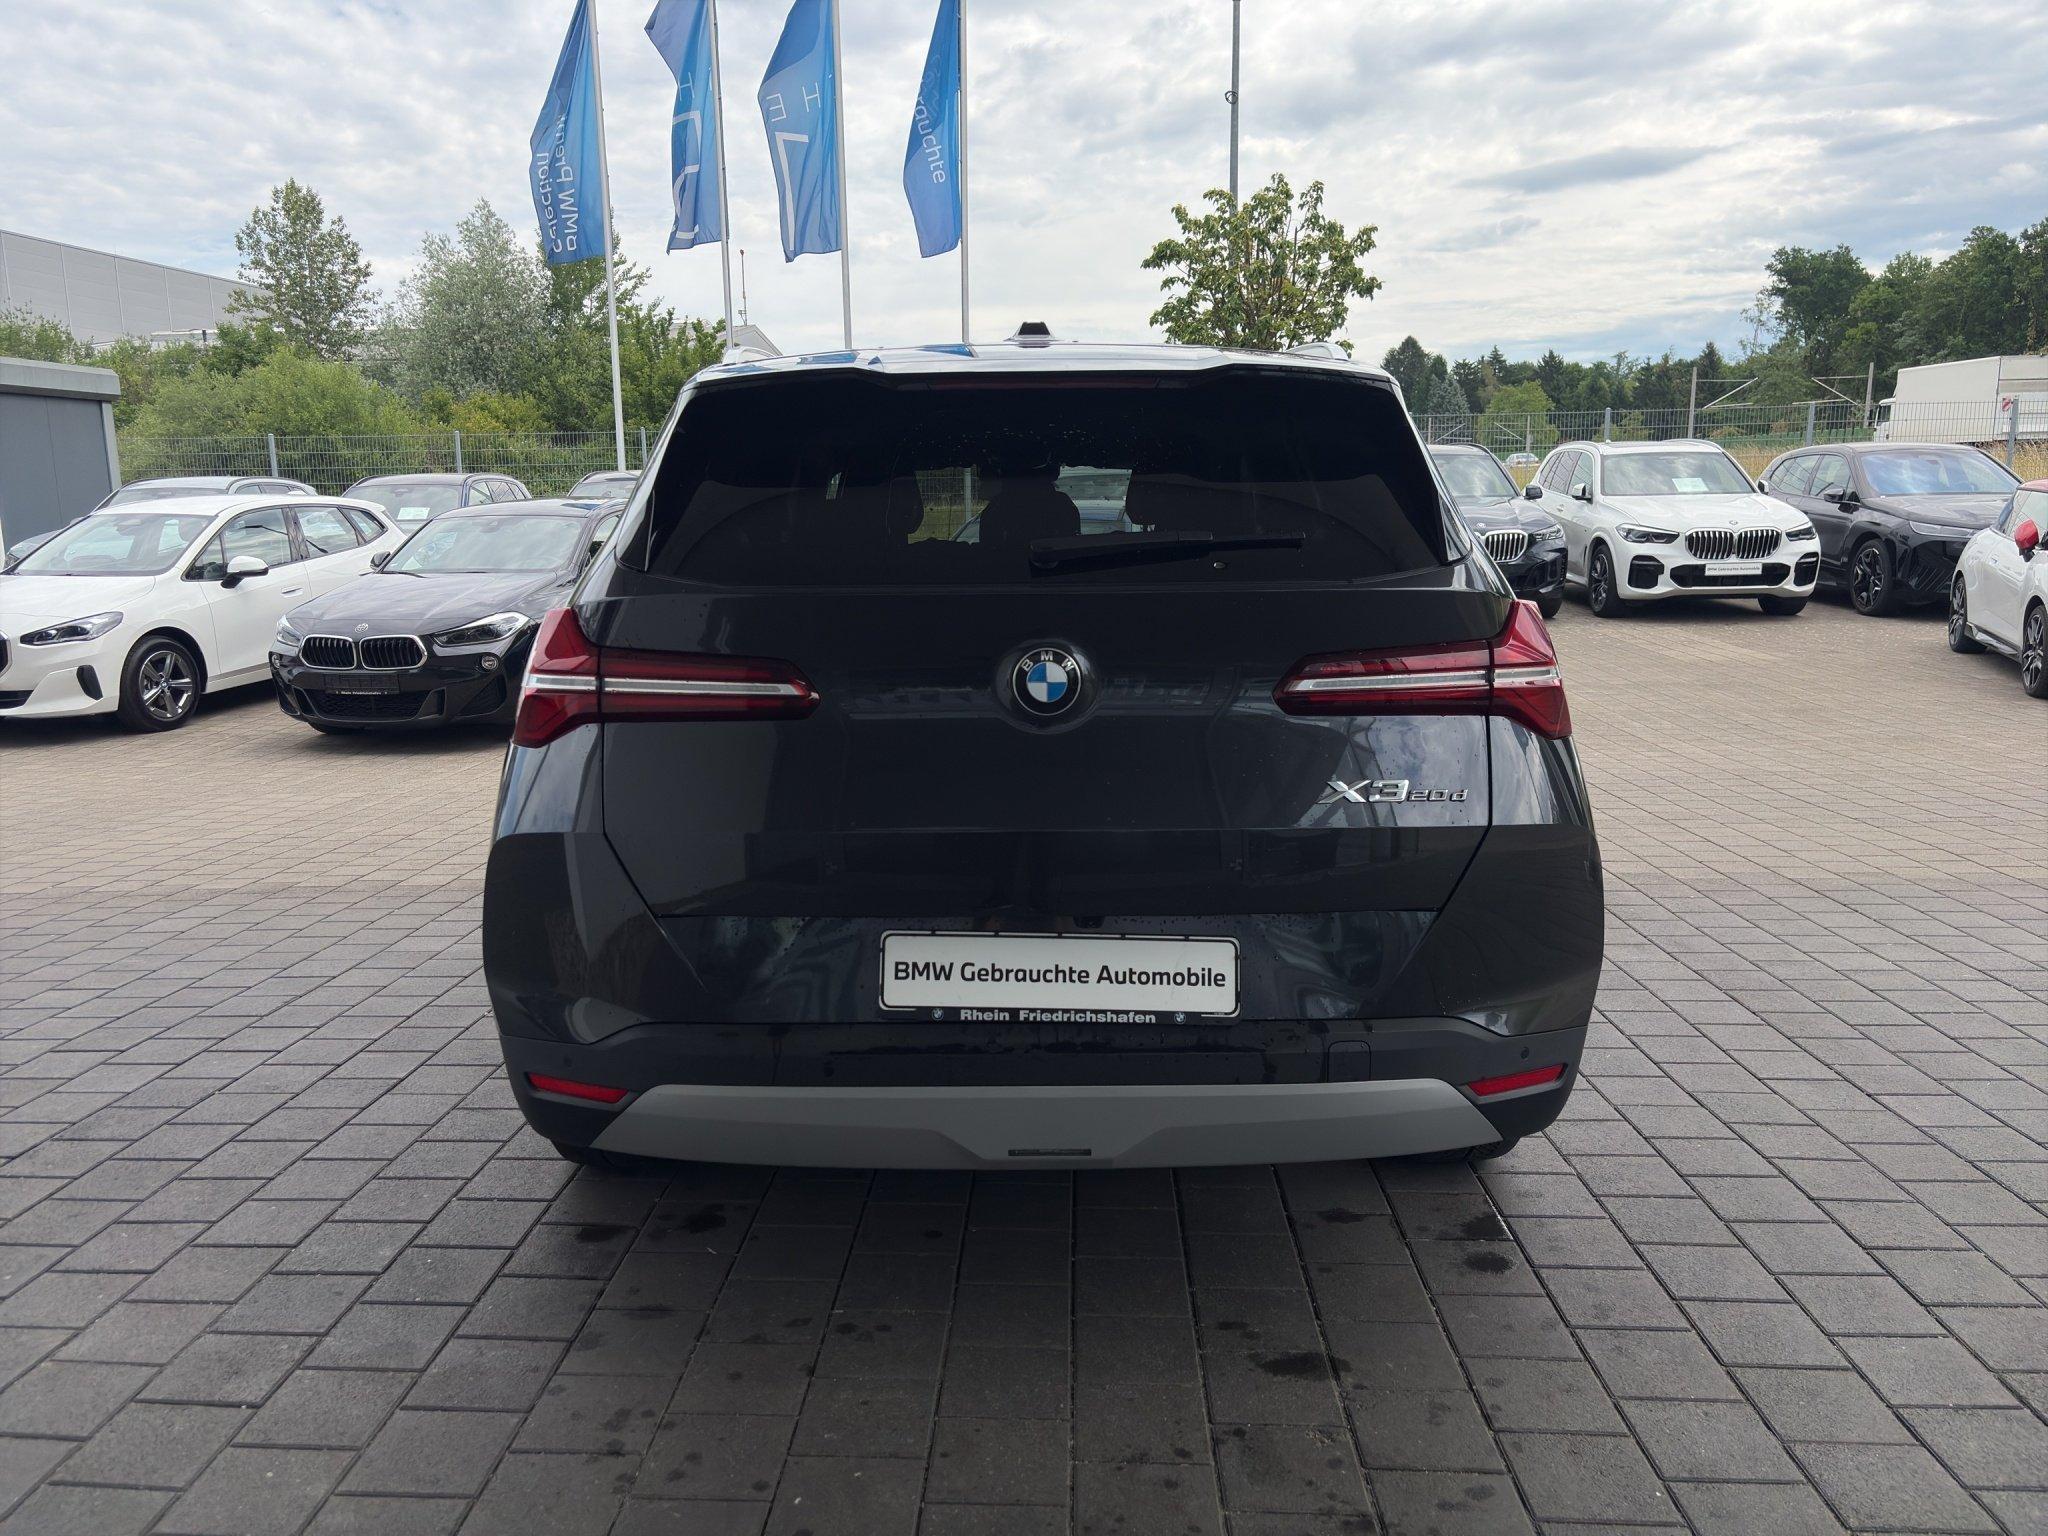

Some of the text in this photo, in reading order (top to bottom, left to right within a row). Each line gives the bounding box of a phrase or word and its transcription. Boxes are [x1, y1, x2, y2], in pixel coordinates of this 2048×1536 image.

[1021, 650, 1075, 672] BMW
[894, 961, 1226, 987] BMW Gebrauchte Automobile
[960, 1009, 1156, 1024] Rhein Friedrichshafen
